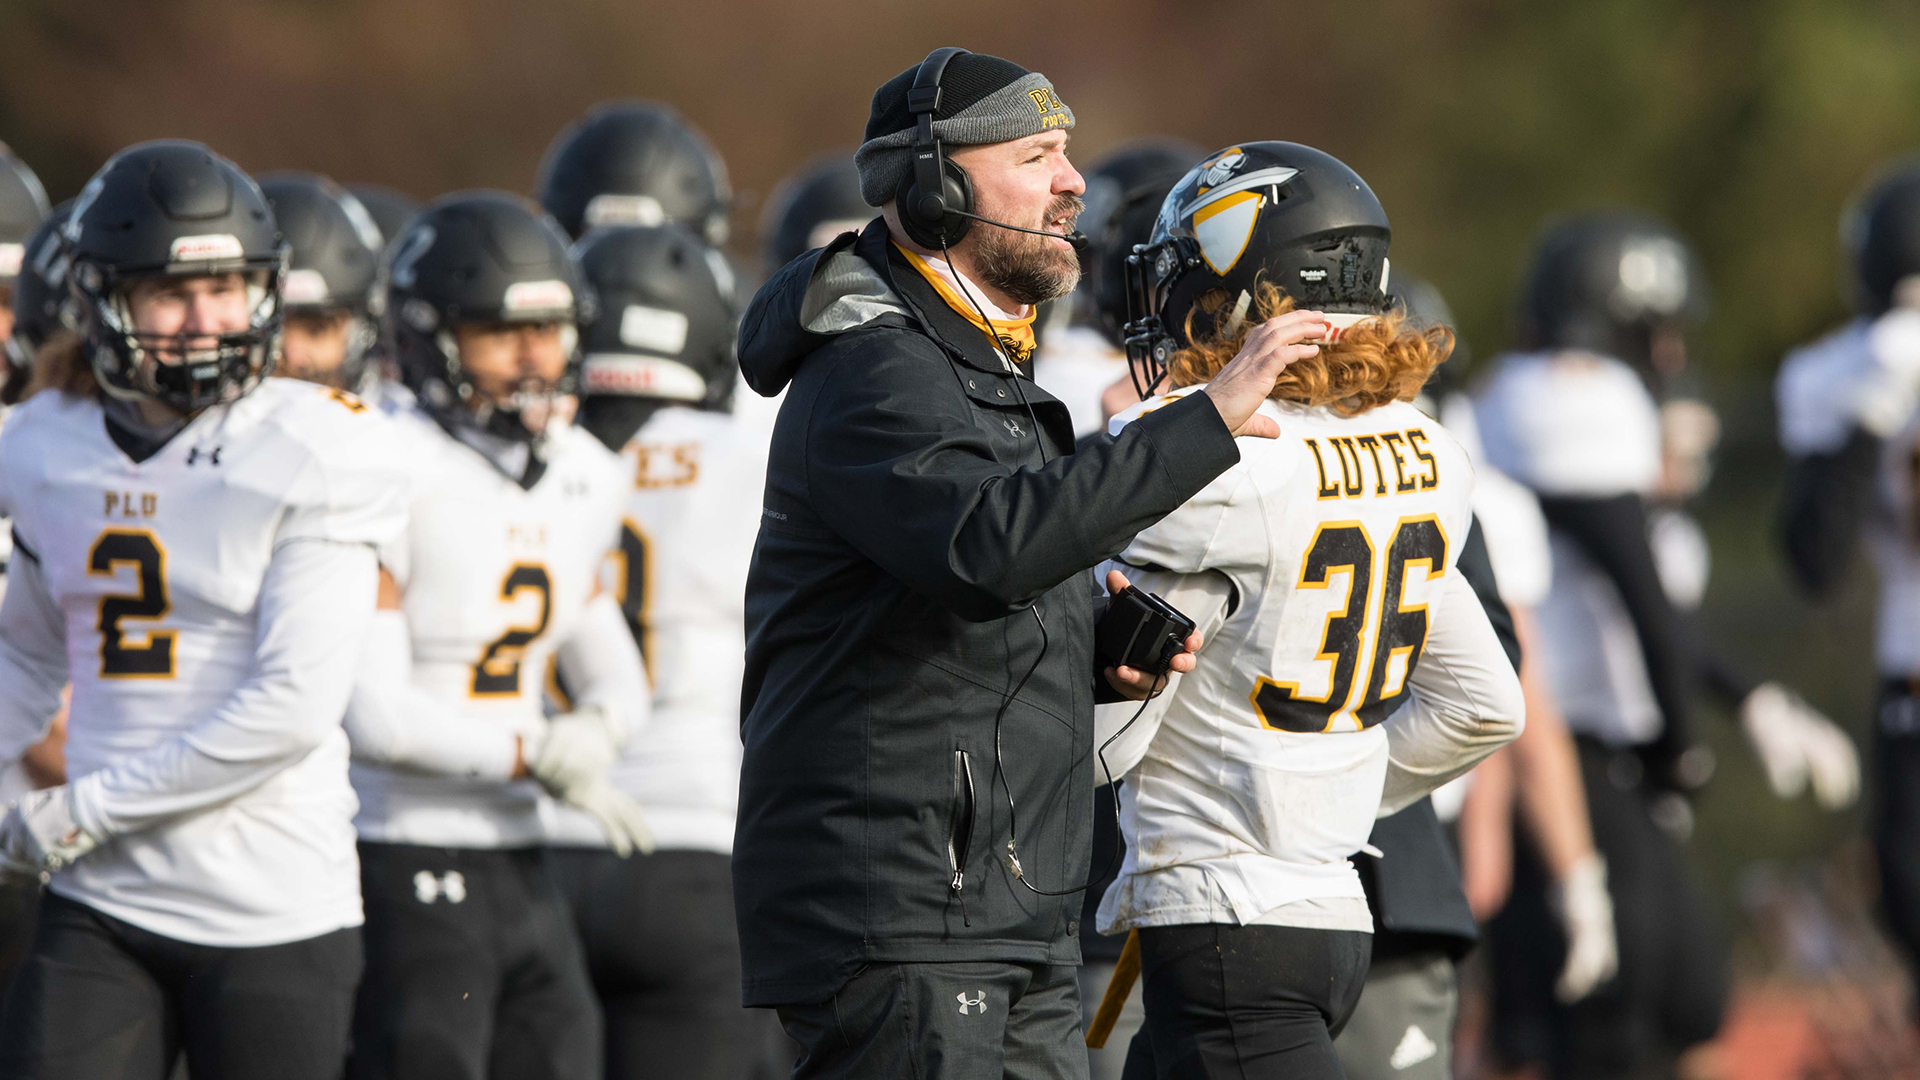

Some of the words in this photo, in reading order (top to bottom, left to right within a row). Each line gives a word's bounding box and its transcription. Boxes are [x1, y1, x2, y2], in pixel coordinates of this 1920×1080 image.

[1028, 87, 1065, 114] PL
[919, 152, 934, 160] HME
[1303, 427, 1440, 501] LUTES
[104, 491, 158, 518] PLU
[86, 525, 178, 681] 2
[468, 562, 553, 699] 2
[1248, 512, 1450, 733] 36
